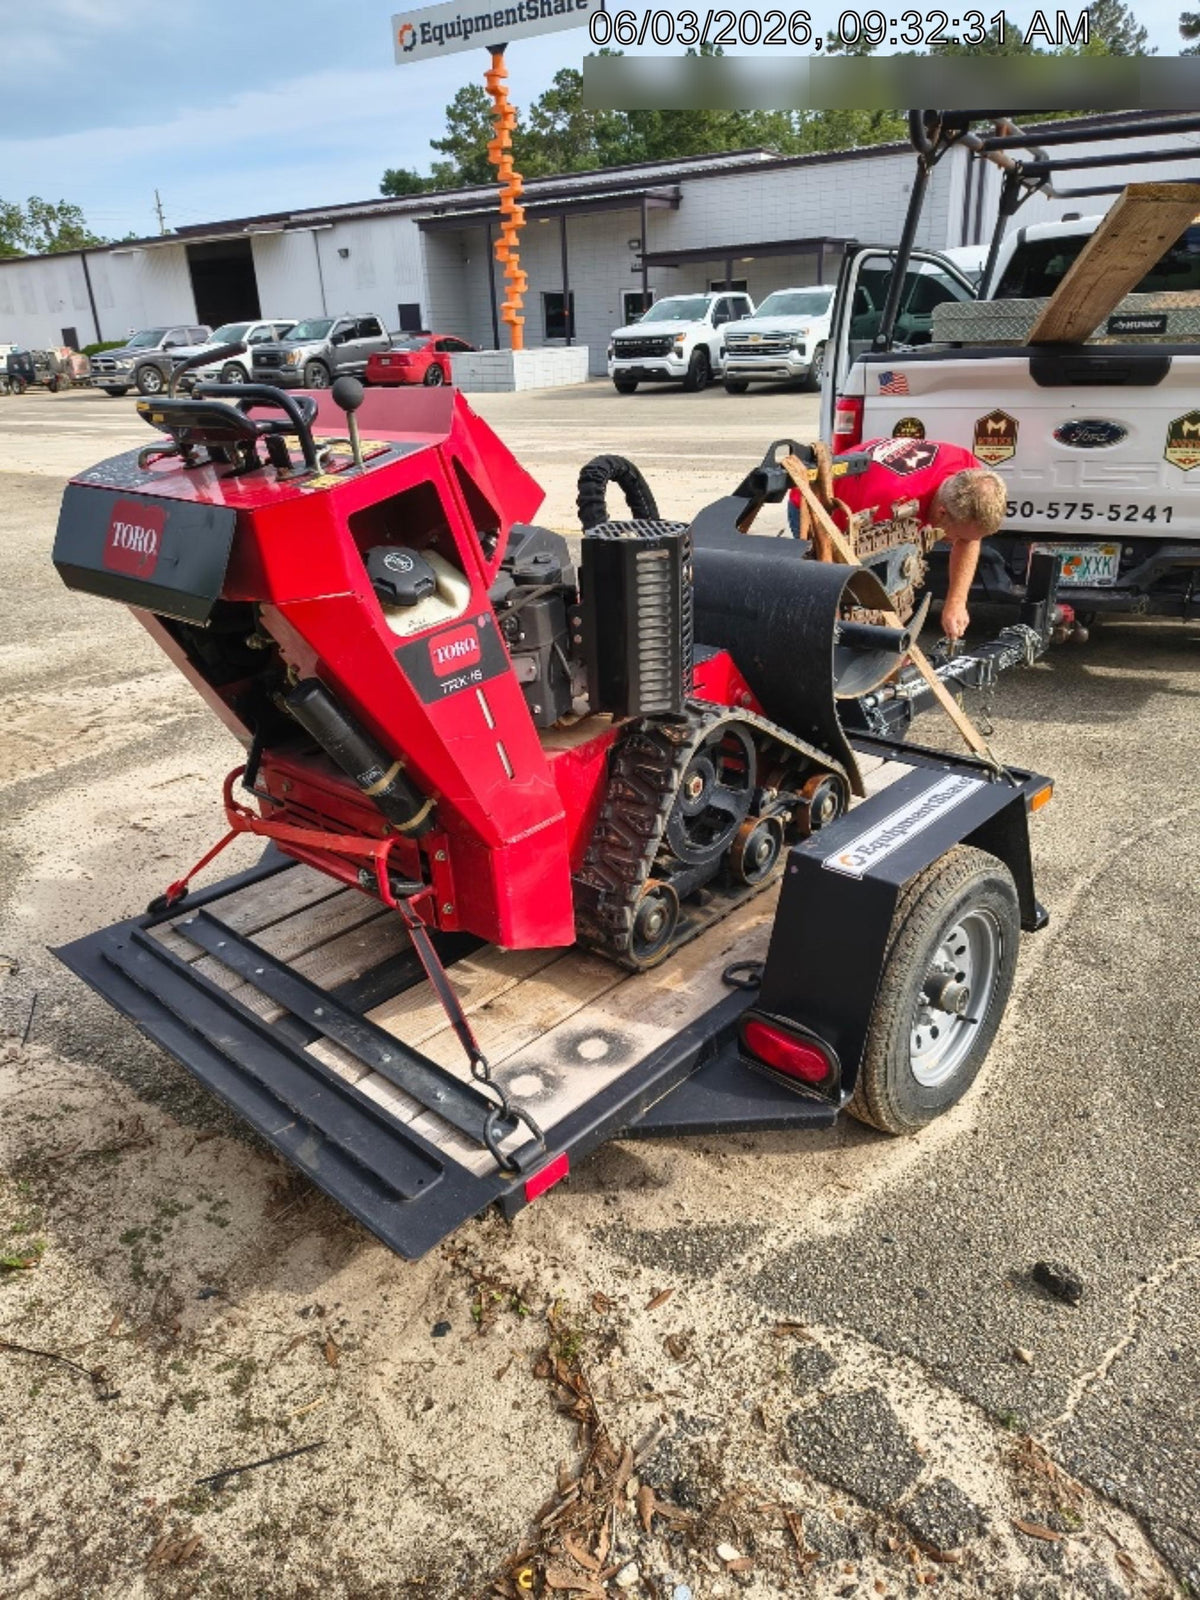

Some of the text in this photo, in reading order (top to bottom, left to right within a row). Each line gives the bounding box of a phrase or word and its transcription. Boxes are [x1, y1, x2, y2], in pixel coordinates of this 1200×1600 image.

[420, 0, 588, 45] EquipmentShare
[1071, 425, 1111, 441] Ford
[112, 521, 157, 554] TORO
[433, 637, 478, 664] TORO
[855, 776, 973, 856] EquipmentShare
